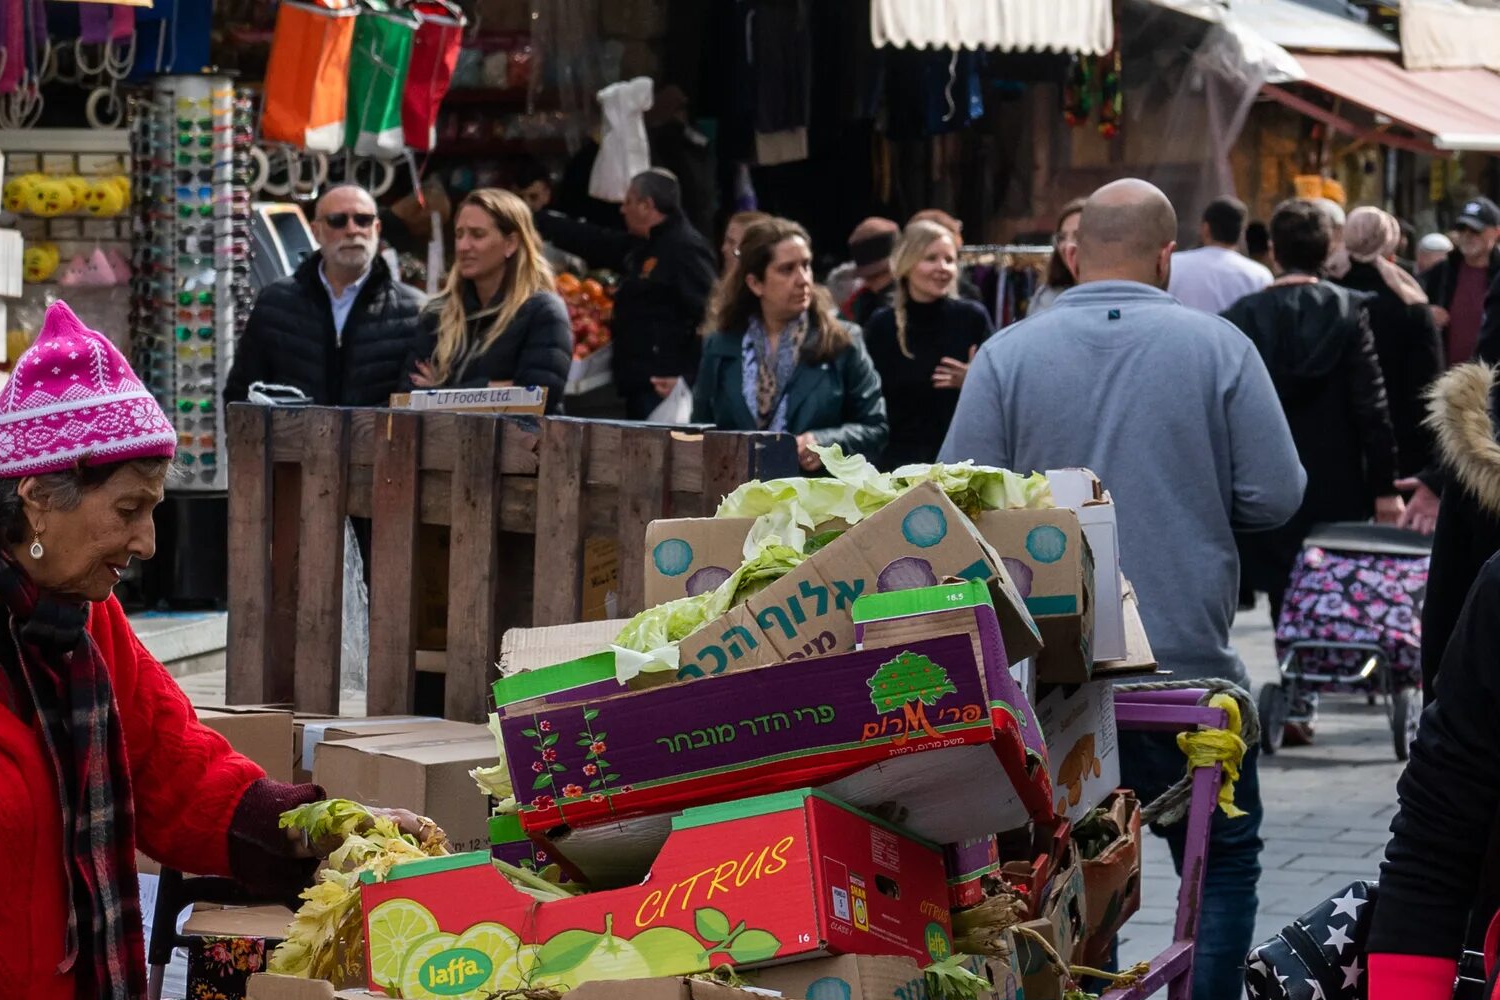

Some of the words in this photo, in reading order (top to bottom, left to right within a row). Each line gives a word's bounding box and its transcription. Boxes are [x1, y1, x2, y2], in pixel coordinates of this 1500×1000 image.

[437, 392, 451, 404] LT
[453, 391, 487, 404] Foods
[490, 389, 512, 402] Ltd.
[756, 579, 864, 640] אלוף
[739, 712, 791, 736] הדר
[797, 704, 836, 724] פרי
[939, 703, 982, 724] פרי
[656, 725, 736, 753] מובחר
[941, 736, 965, 747] משק
[469, 837, 481, 850] 12
[635, 836, 794, 927] CITRUS
[920, 900, 948, 923] CITRUS
[798, 934, 810, 943] 16
